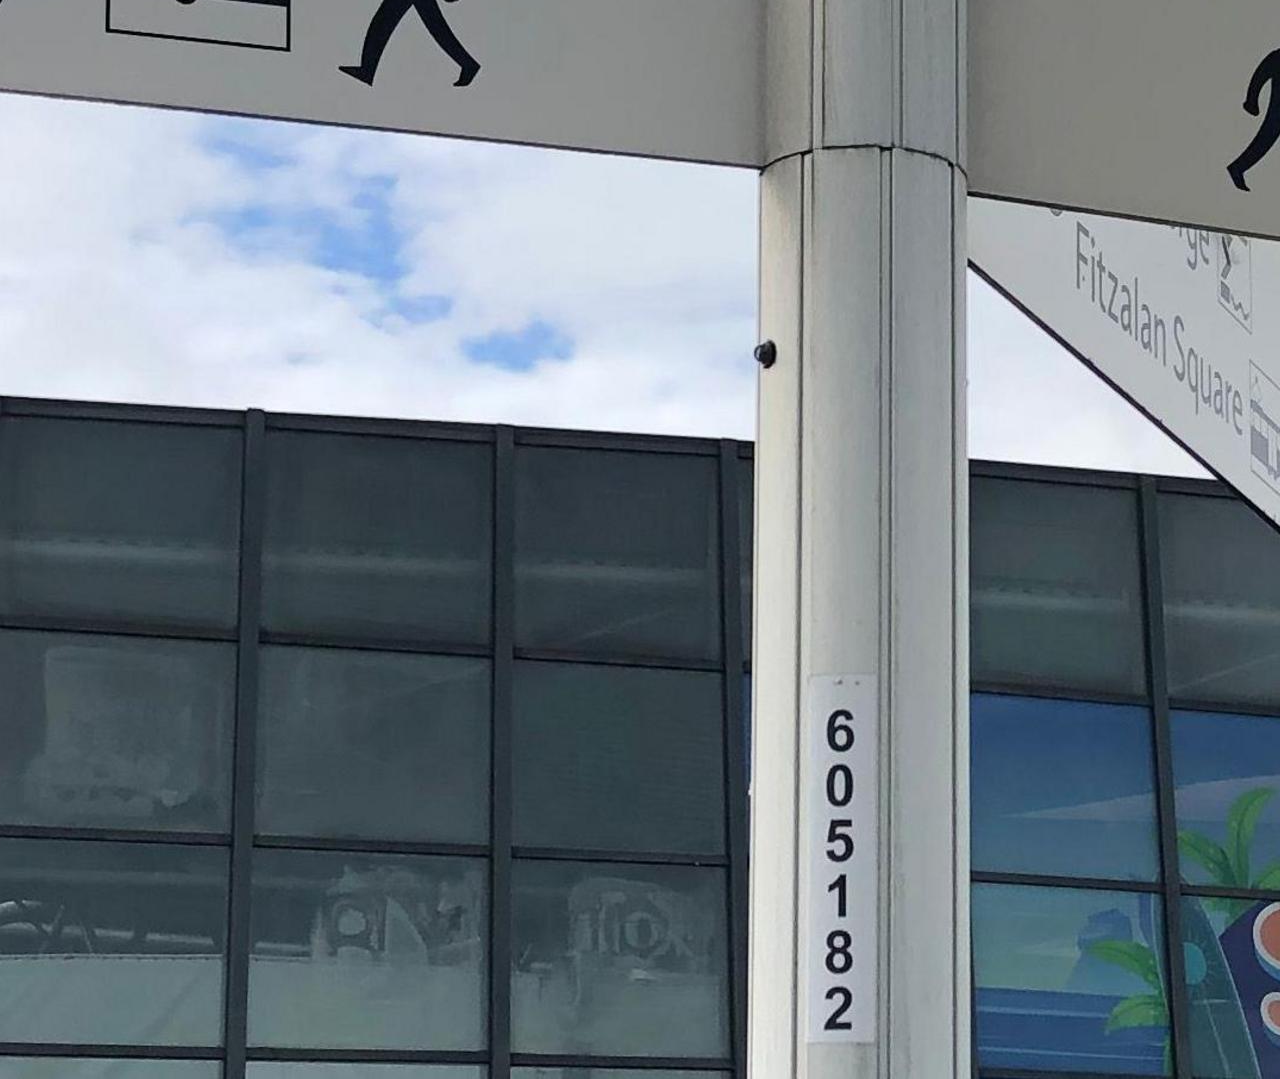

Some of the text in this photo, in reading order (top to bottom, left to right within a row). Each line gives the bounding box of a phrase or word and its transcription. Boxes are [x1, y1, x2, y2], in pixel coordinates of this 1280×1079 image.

[1075, 220, 1244, 436] Fitzalan Square
[823, 709, 855, 1031] 605182
